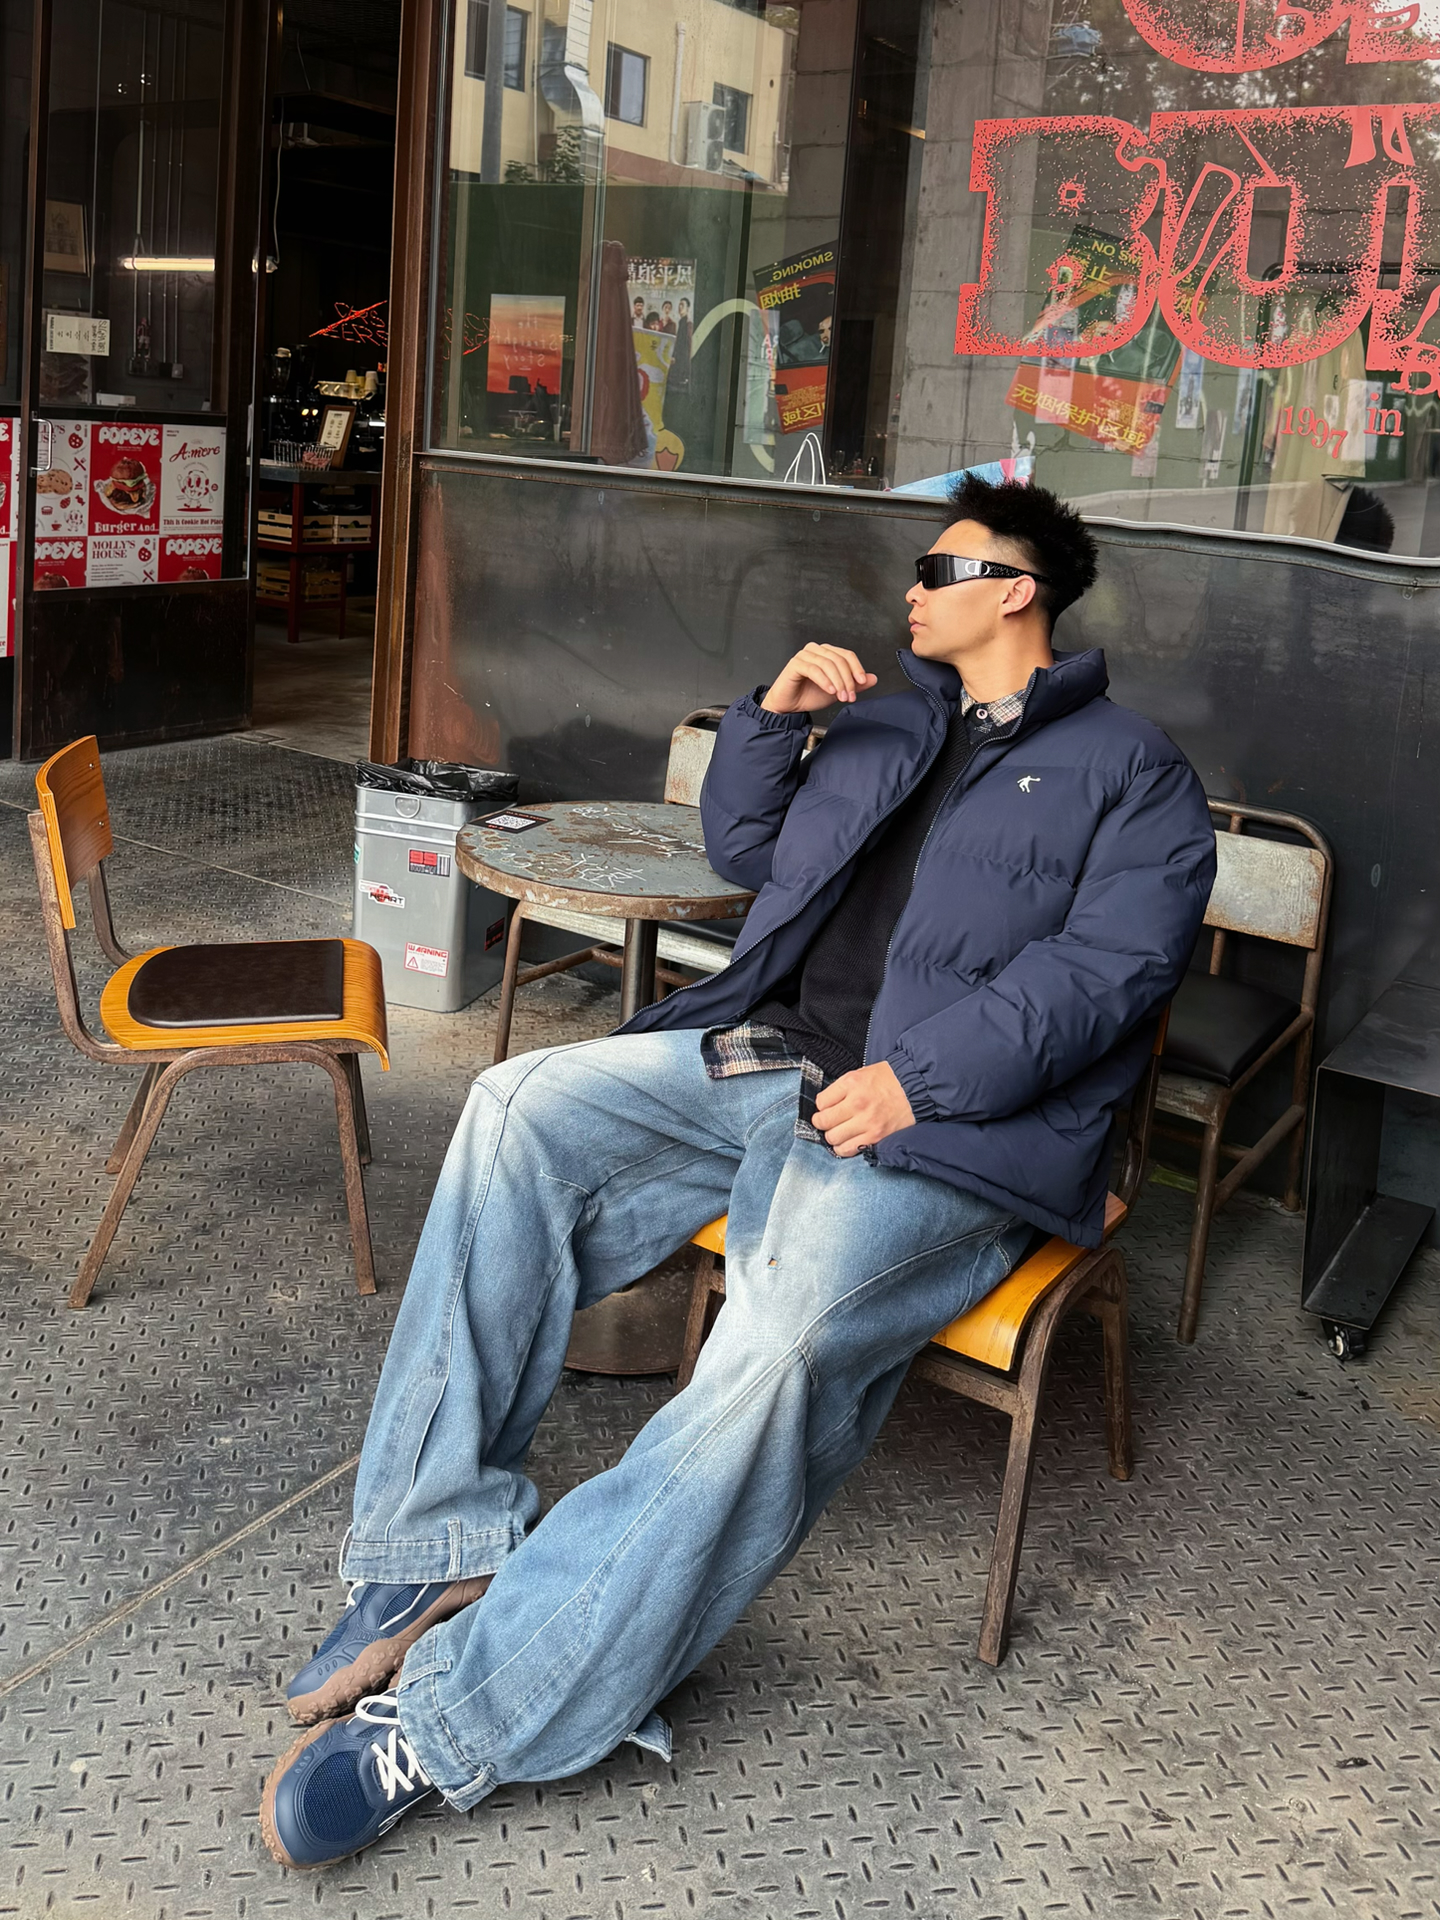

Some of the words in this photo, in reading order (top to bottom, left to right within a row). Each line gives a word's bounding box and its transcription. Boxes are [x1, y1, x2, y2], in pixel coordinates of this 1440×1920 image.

[1091, 240, 1116, 257] NO
[1012, 383, 1148, 449] 无烟保护区域
[1280, 405, 1348, 459] 1997
[1364, 392, 1404, 437] in
[98, 426, 160, 446] POPEYE
[94, 520, 137, 535] Burger
[163, 518, 174, 526] This
[92, 540, 136, 550] MOLLY'S
[166, 537, 222, 556] POPEYE
[92, 549, 128, 559] HOUSE
[408, 944, 447, 958] WARNING
